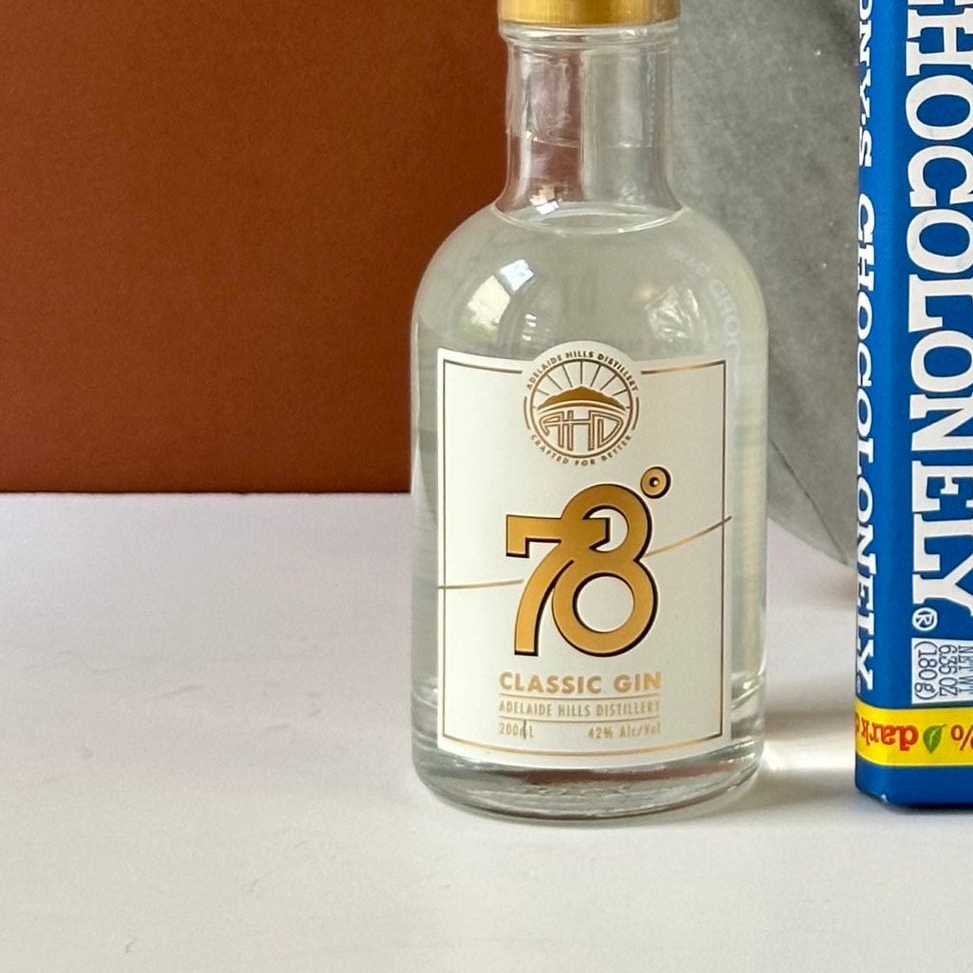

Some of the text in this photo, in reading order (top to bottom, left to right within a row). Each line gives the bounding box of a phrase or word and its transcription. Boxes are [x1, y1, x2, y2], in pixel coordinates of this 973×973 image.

[526, 350, 639, 391] ADELAIDE HILLS DISTILLERY
[530, 434, 632, 467] CRAFTED FOR BETTER
[499, 671, 662, 694] CLASSIC GIN
[938, 644, 958, 696] 6.35 OZ
[499, 699, 661, 717] ADELAIDE HILLS DISTILLERY
[588, 725, 613, 740] 42%
[861, 717, 919, 752] dark
